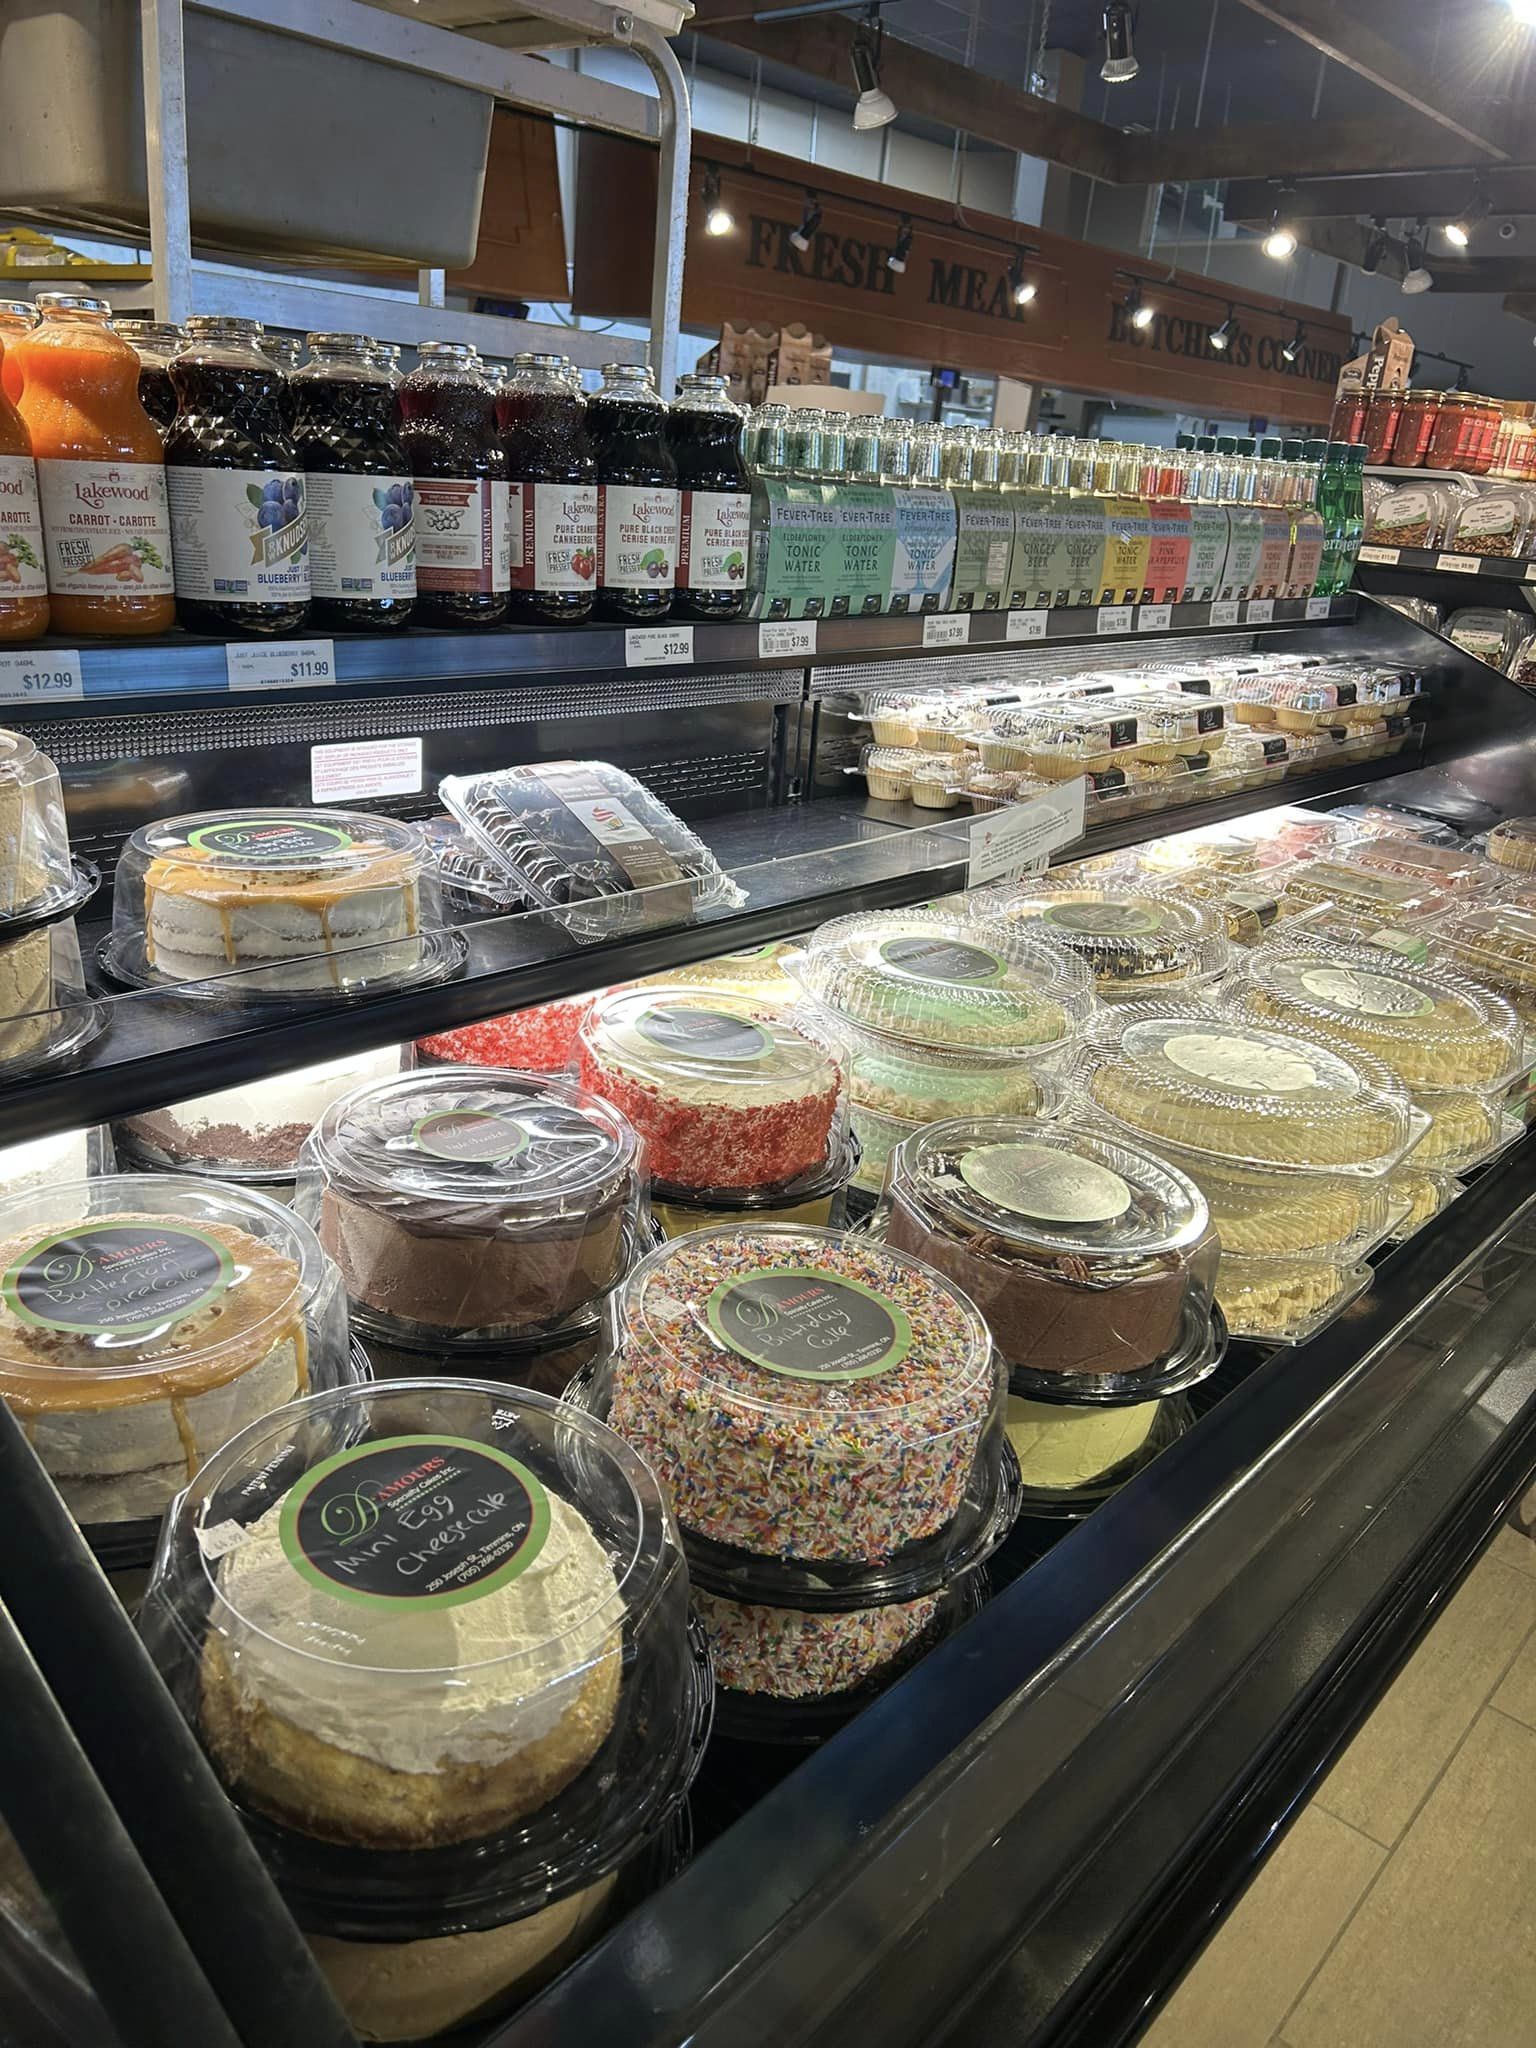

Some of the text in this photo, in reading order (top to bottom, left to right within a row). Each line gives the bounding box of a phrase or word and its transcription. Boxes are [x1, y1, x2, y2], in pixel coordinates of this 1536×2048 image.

[744, 213, 897, 295] FRESH
[75, 482, 149, 509] Lakewood
[1, 511, 31, 524] AROTTE
[69, 513, 157, 527] CARROT CAROTTE
[777, 508, 834, 522] FEVER-TREE
[900, 510, 951, 522] FEVER-TREE
[965, 514, 1009, 527] FEVER-TREE
[1021, 516, 1062, 529] FEVER-TREE
[1111, 520, 1149, 532] FEVER-TREE
[555, 524, 575, 534] PURE
[619, 524, 640, 533] PURE
[641, 525, 662, 534] BLACK
[704, 528, 723, 537] PURE
[483, 508, 492, 566] PREMIUM
[525, 509, 535, 566] PREMIUM
[621, 535, 649, 544] CERISE
[681, 514, 691, 565] PREMIUM
[706, 538, 729, 547] CERISE
[783, 533, 826, 542] ELDERFLOWER
[842, 534, 883, 542] ELDERFLOWER
[58, 541, 91, 556] FRESH
[787, 545, 821, 557] TONIC
[846, 545, 879, 557] TONIC
[910, 549, 936, 558] TONIC
[1023, 544, 1057, 555] GINGER
[1067, 544, 1098, 555] GINGER
[784, 560, 821, 572] WATER
[843, 559, 879, 571] WATER
[907, 560, 936, 570] WATER
[1027, 557, 1048, 568] BEER
[257, 573, 301, 584] BLUEBERRY
[949, 627, 963, 638] $7.99
[791, 636, 809, 647] $7.99
[663, 642, 690, 655] $12.99
[290, 661, 329, 677] $11.99
[23, 672, 73, 690] $12.99
[240, 1471, 270, 1497] PATENT
[387, 1486, 421, 1509] Specialty
[419, 1474, 442, 1490] Cakes
[333, 1495, 454, 1575] Mini Egg
[425, 1578, 444, 1592] 250
[511, 1521, 527, 1533] ON
[457, 1564, 481, 1583] (705)
